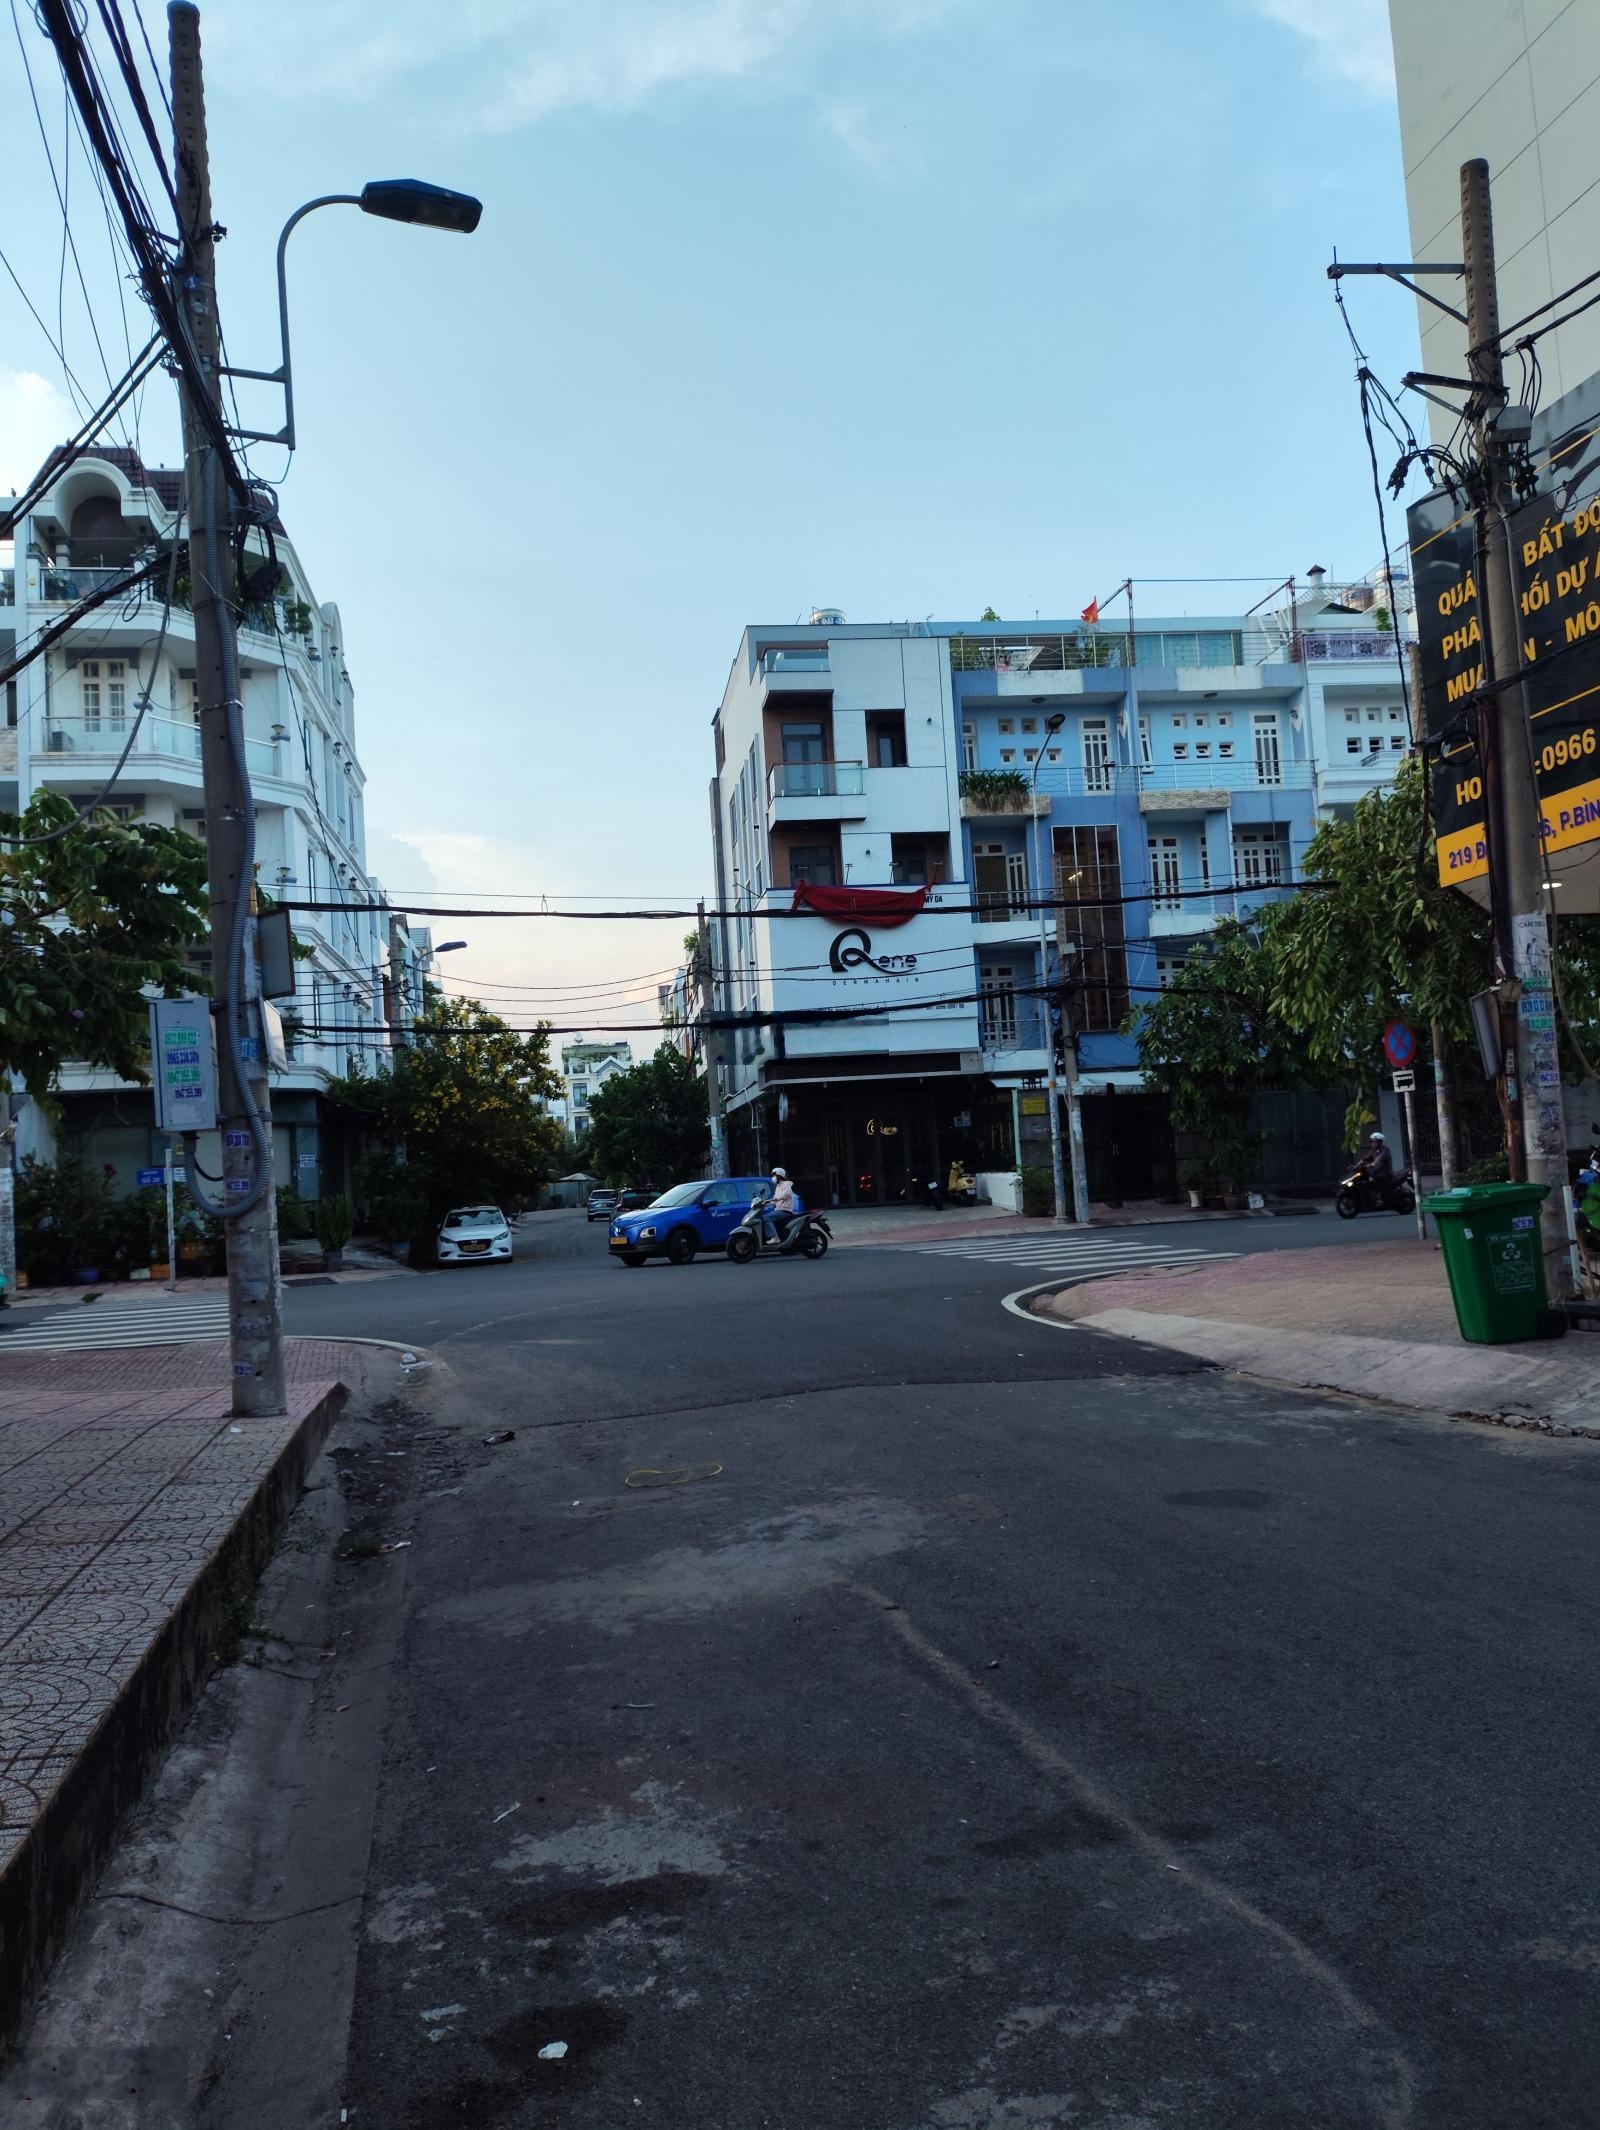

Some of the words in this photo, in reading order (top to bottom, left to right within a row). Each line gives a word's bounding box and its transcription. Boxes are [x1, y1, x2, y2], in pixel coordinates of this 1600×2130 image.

[1523, 517, 1566, 567] BẤT
[1573, 494, 1600, 538] ĐỘ
[1556, 556, 1590, 599] DỰ
[1449, 846, 1472, 869] 219
